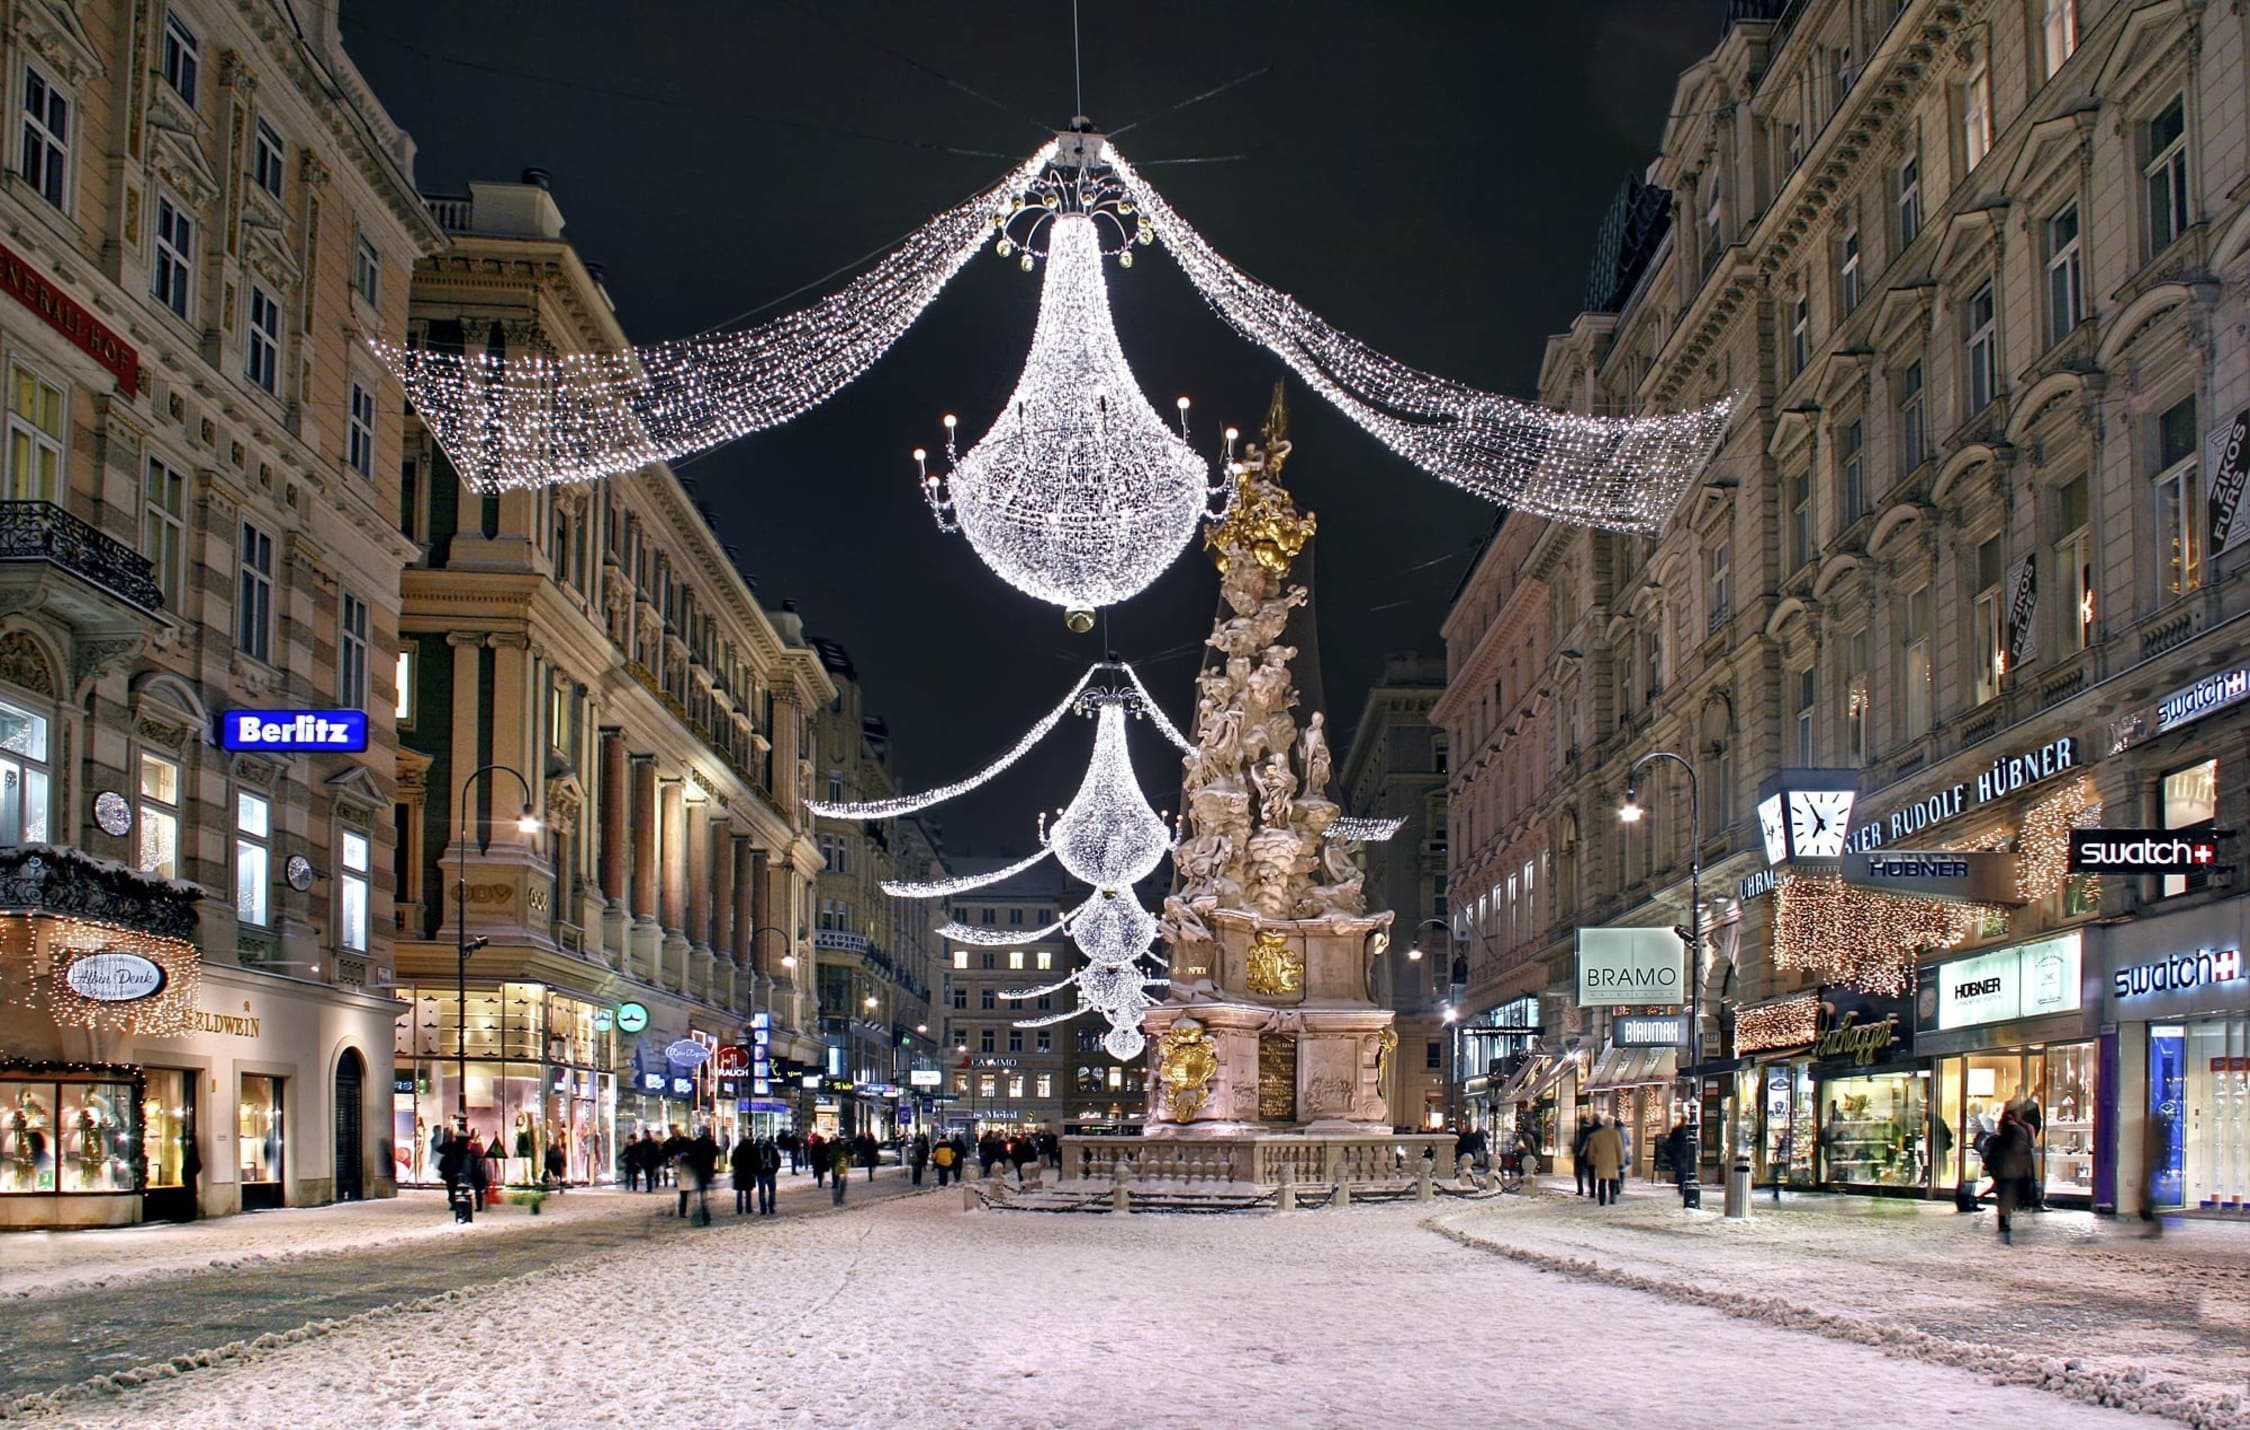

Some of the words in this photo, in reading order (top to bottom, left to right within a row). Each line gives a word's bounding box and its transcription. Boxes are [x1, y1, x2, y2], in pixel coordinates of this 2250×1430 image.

[0, 253, 80, 337] NERALI
[90, 323, 130, 370] HOF
[2212, 423, 2247, 504] ZIKOS
[2213, 469, 2246, 541] FURS
[2011, 563, 2035, 627] ZIKOS
[2012, 590, 2036, 657] PELZE
[2157, 676, 2227, 727] swatch
[239, 714, 349, 743] Berlitz
[1891, 784, 1965, 839] RUDOLF
[1978, 737, 2071, 803] HÜBNER
[2080, 838, 2192, 864] swatch
[114, 969, 154, 986] Denk
[1587, 967, 1677, 987] BRAMO
[2113, 949, 2213, 999] swatch
[718, 1068, 749, 1078] RAUCH
